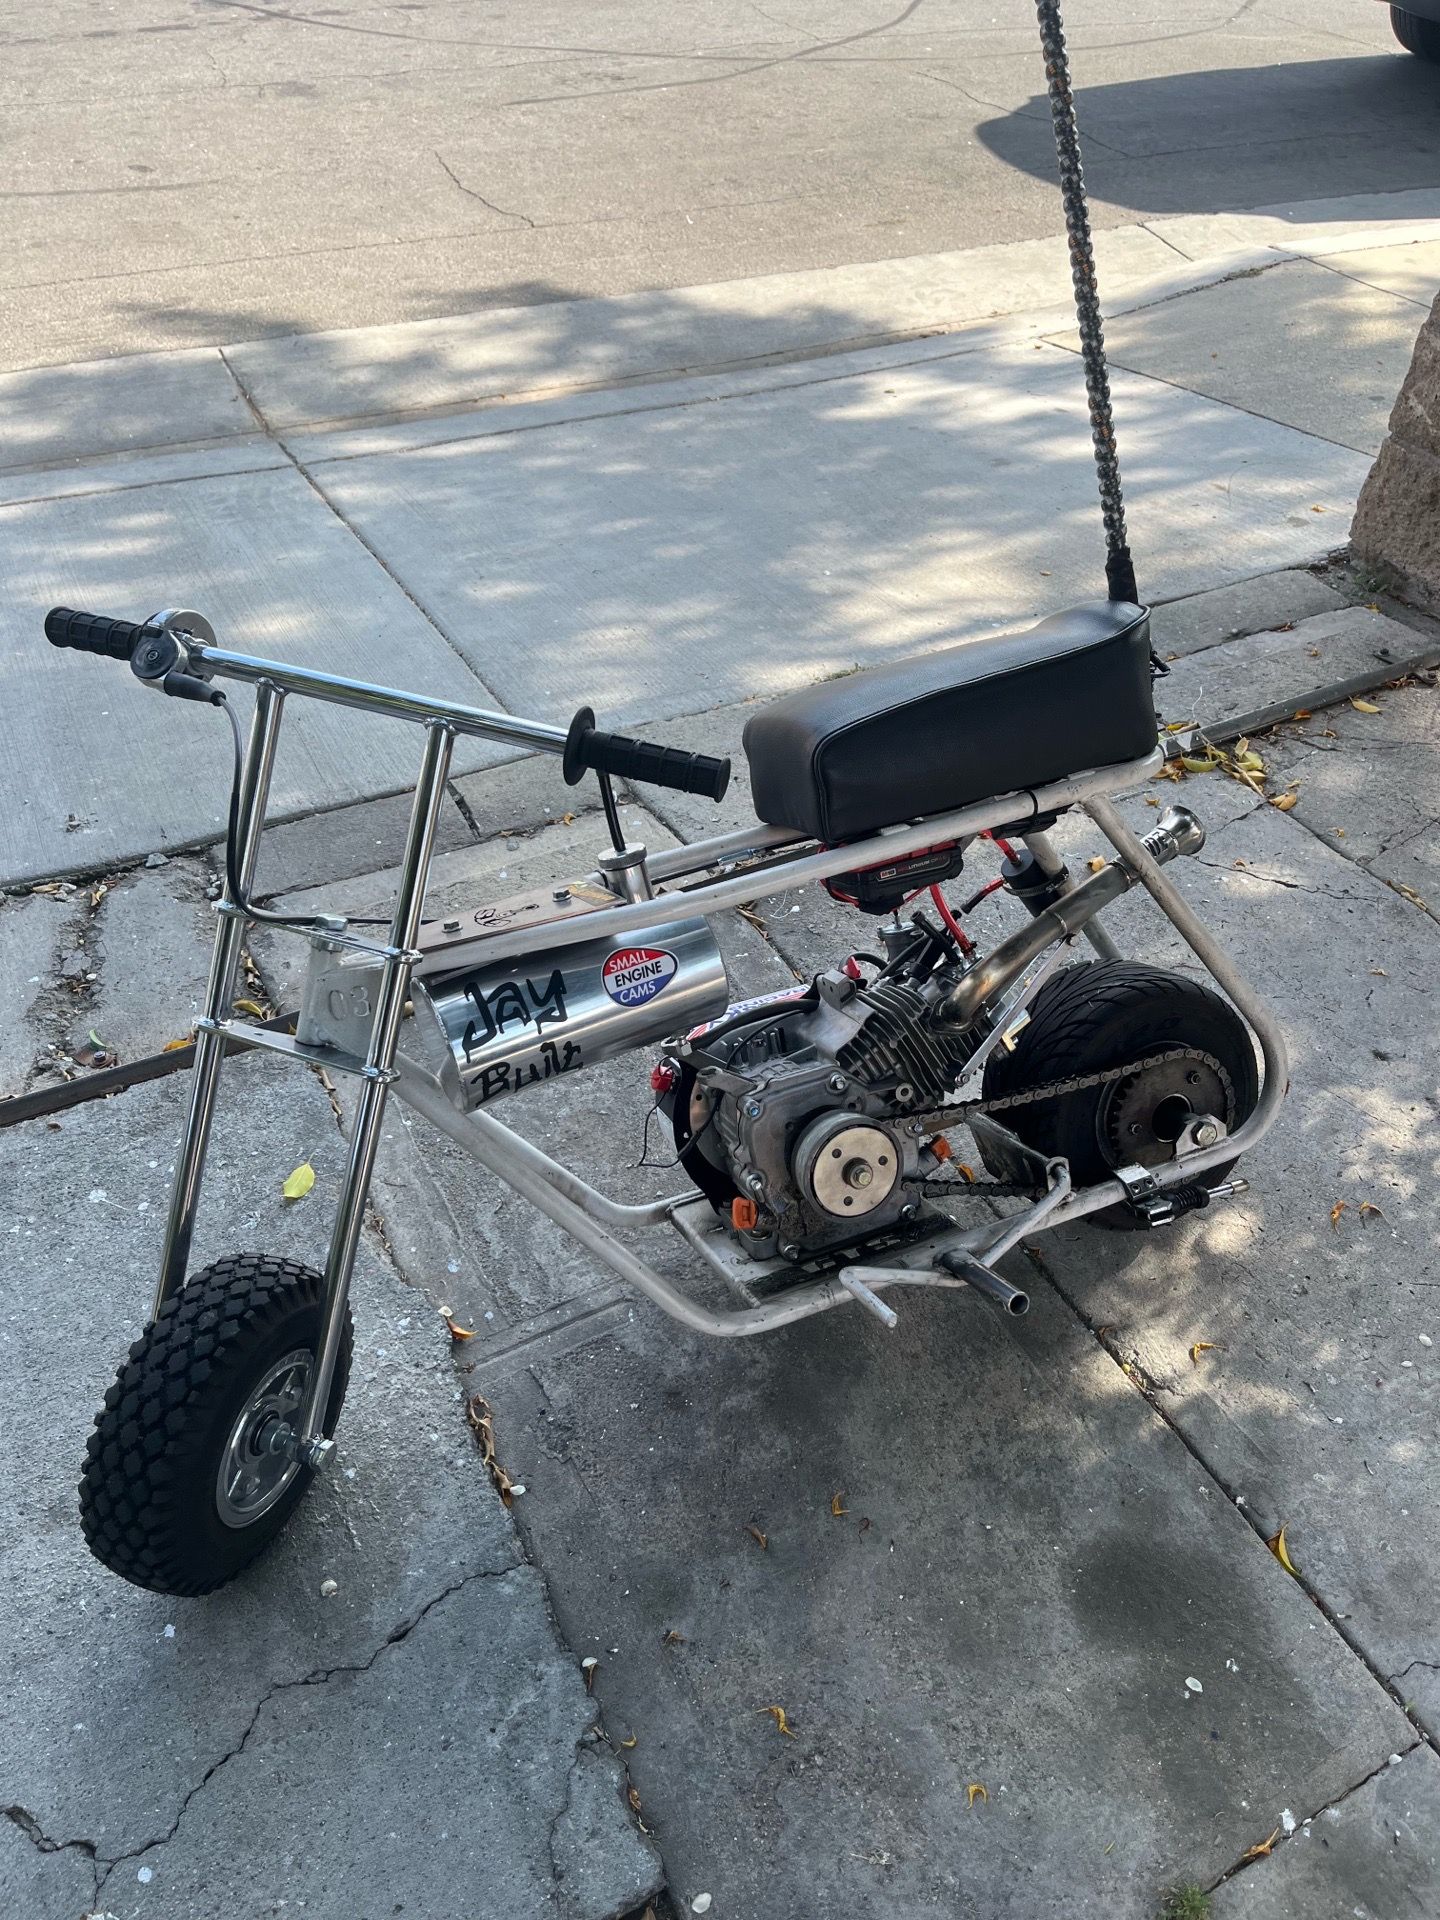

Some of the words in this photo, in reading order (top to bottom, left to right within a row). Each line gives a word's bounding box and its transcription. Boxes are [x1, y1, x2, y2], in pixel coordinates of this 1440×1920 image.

[609, 950, 649, 972] SMALL
[615, 961, 662, 988] ENGINE
[329, 986, 371, 1020] 03
[620, 981, 656, 1003] CAMS
